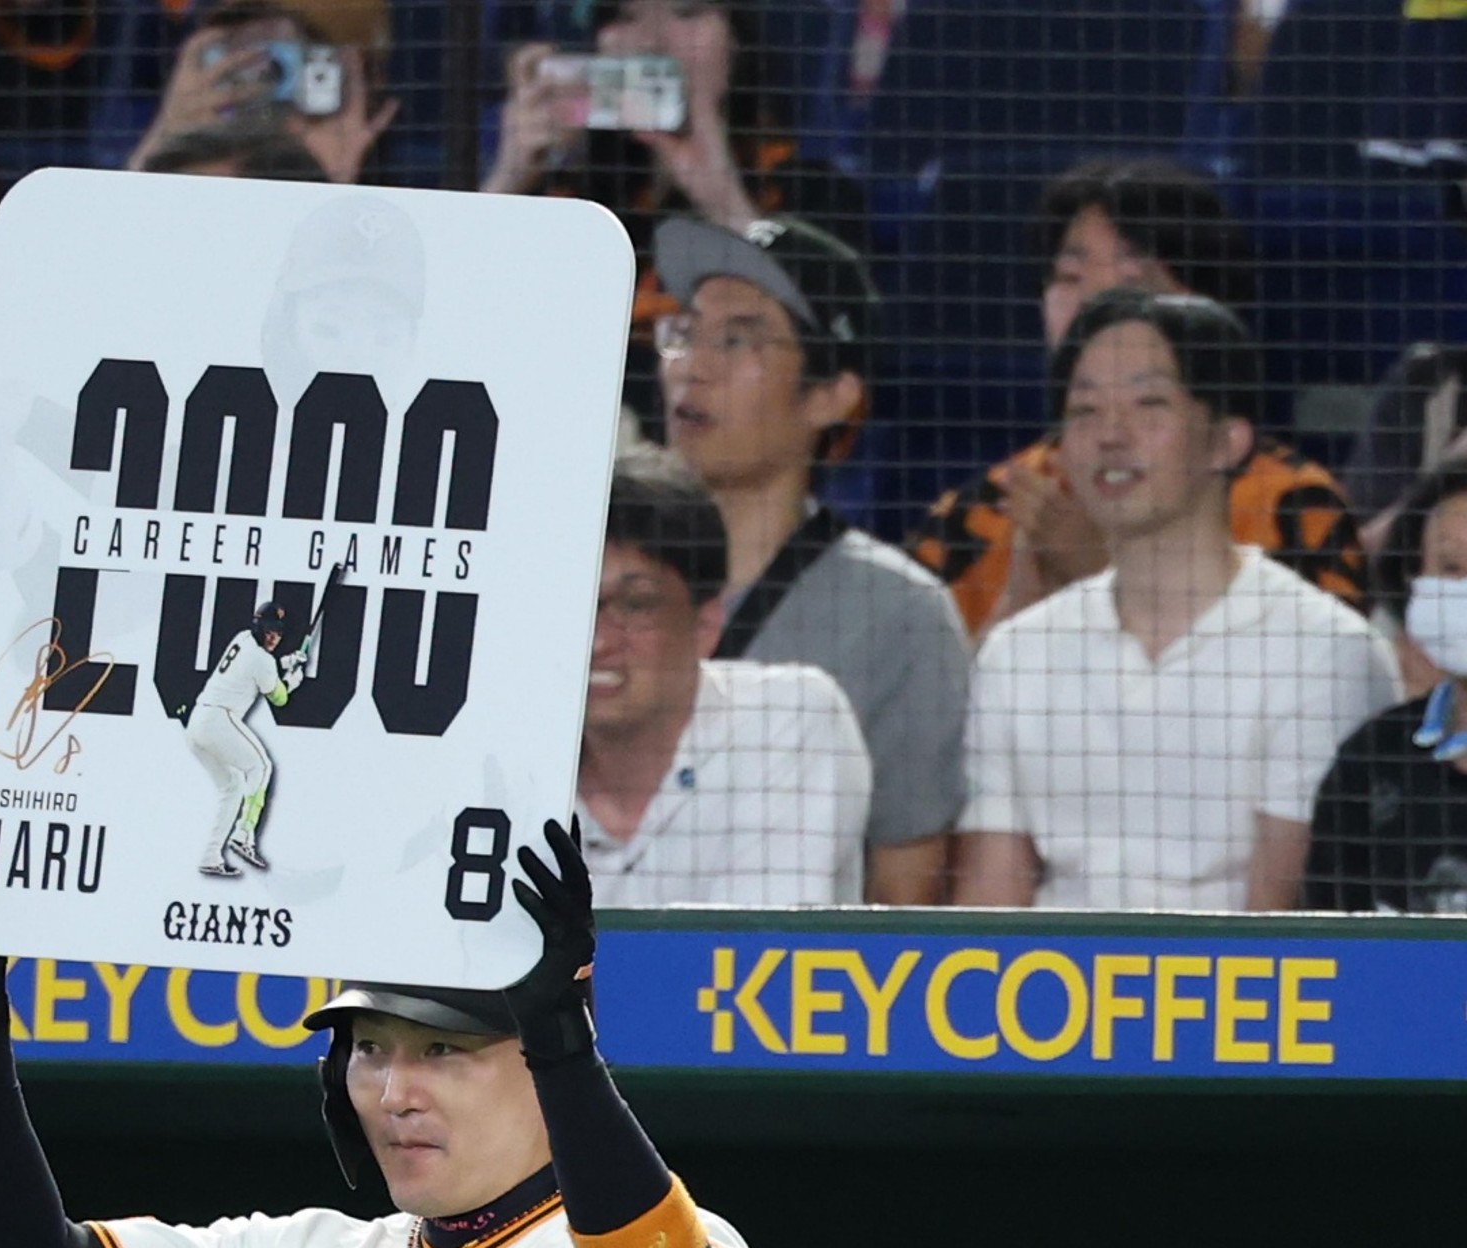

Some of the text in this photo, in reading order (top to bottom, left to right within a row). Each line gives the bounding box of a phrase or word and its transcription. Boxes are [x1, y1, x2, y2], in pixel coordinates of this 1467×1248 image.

[73, 515, 472, 580] CAREER GAMES
[444, 806, 512, 923] 8
[163, 900, 294, 948] GIANTS
